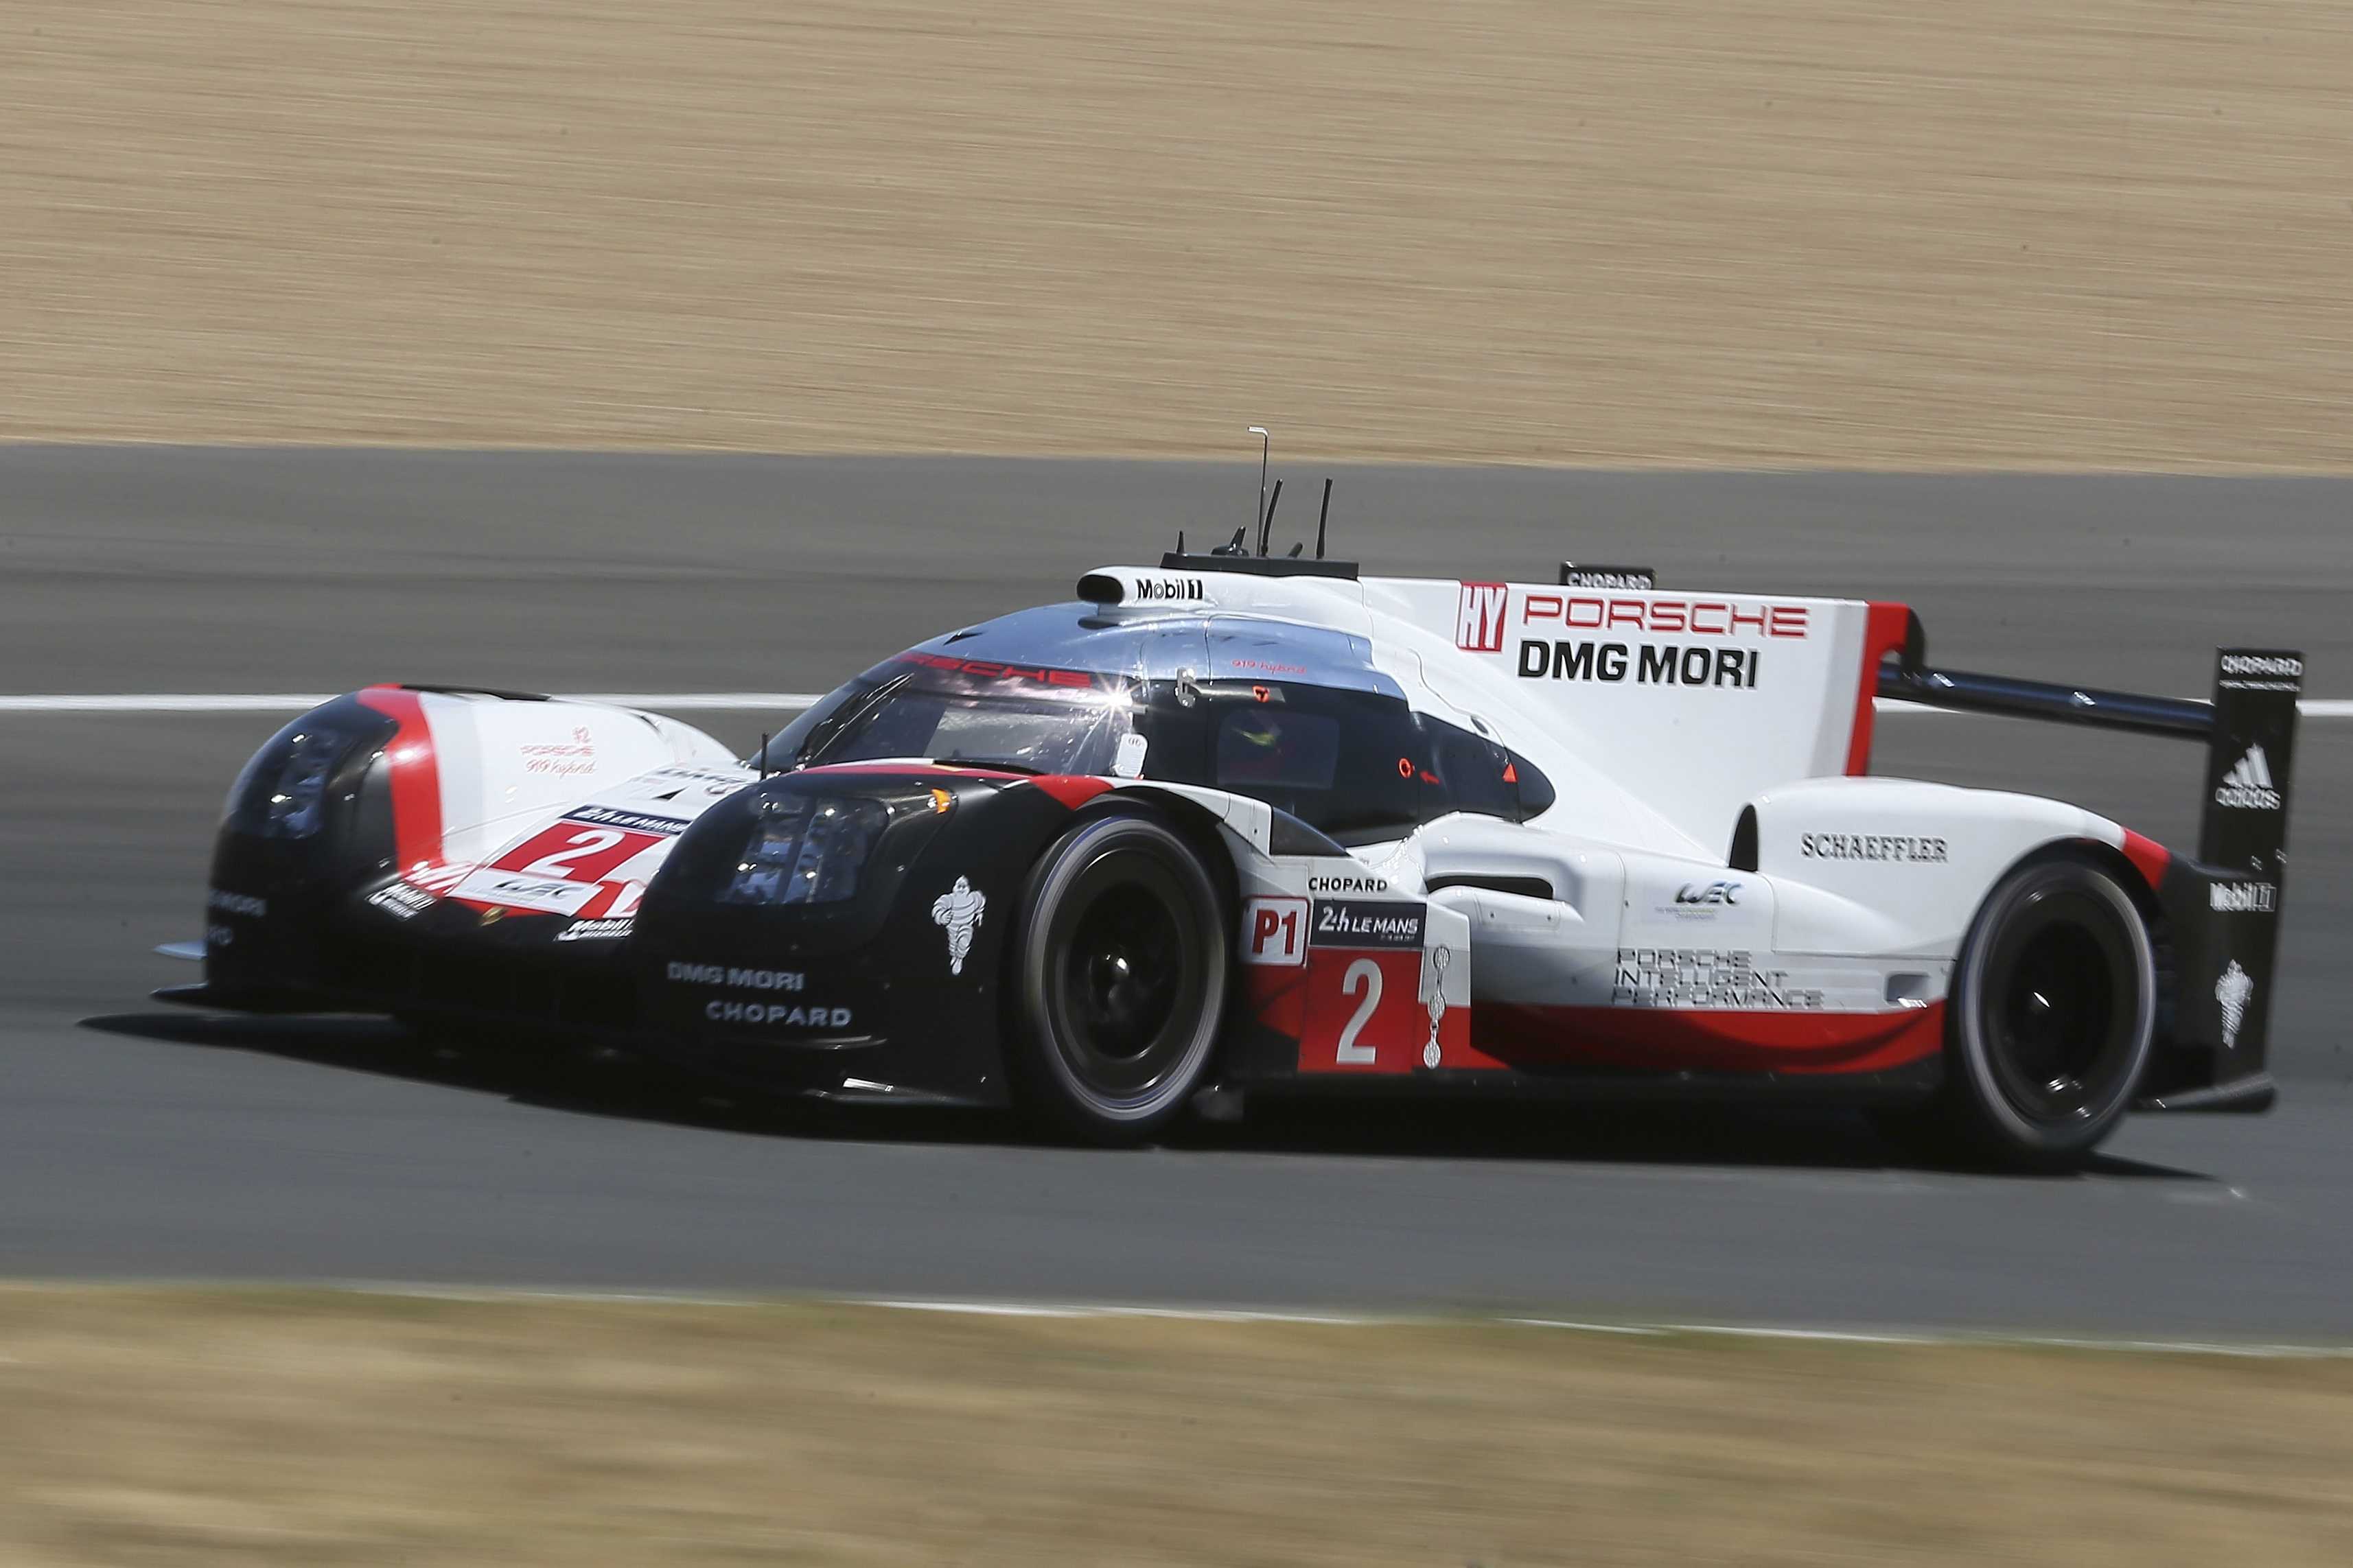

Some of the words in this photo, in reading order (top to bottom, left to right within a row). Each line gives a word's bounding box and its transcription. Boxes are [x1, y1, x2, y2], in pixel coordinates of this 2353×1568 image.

[1135, 578, 1185, 599] Mobil
[1566, 572, 1652, 590] CHOPARD
[1457, 585, 1507, 648] HY
[1522, 596, 1808, 638] PORSCHE
[1517, 640, 1628, 681] DMG
[1638, 644, 1760, 688] MORI
[2215, 787, 2281, 810] adidas
[518, 828, 626, 879] 2
[1801, 832, 1948, 863] SCHAEFFLER
[1308, 878, 1388, 891] CHOPARD
[1675, 882, 1743, 905] WEC
[1252, 909, 1297, 955] P1
[1319, 906, 1349, 933] 24h
[1352, 917, 1372, 933] LE
[1373, 917, 1419, 935] MANS
[1616, 949, 1752, 969] PORSCHE
[667, 961, 724, 983] DMG
[726, 967, 805, 992] MORI
[1614, 968, 1788, 989] INTELLIGENT
[1336, 959, 1383, 1064] 2
[1612, 987, 1824, 1010] PERFORMANCE
[705, 1000, 853, 1027] CHOPARD
